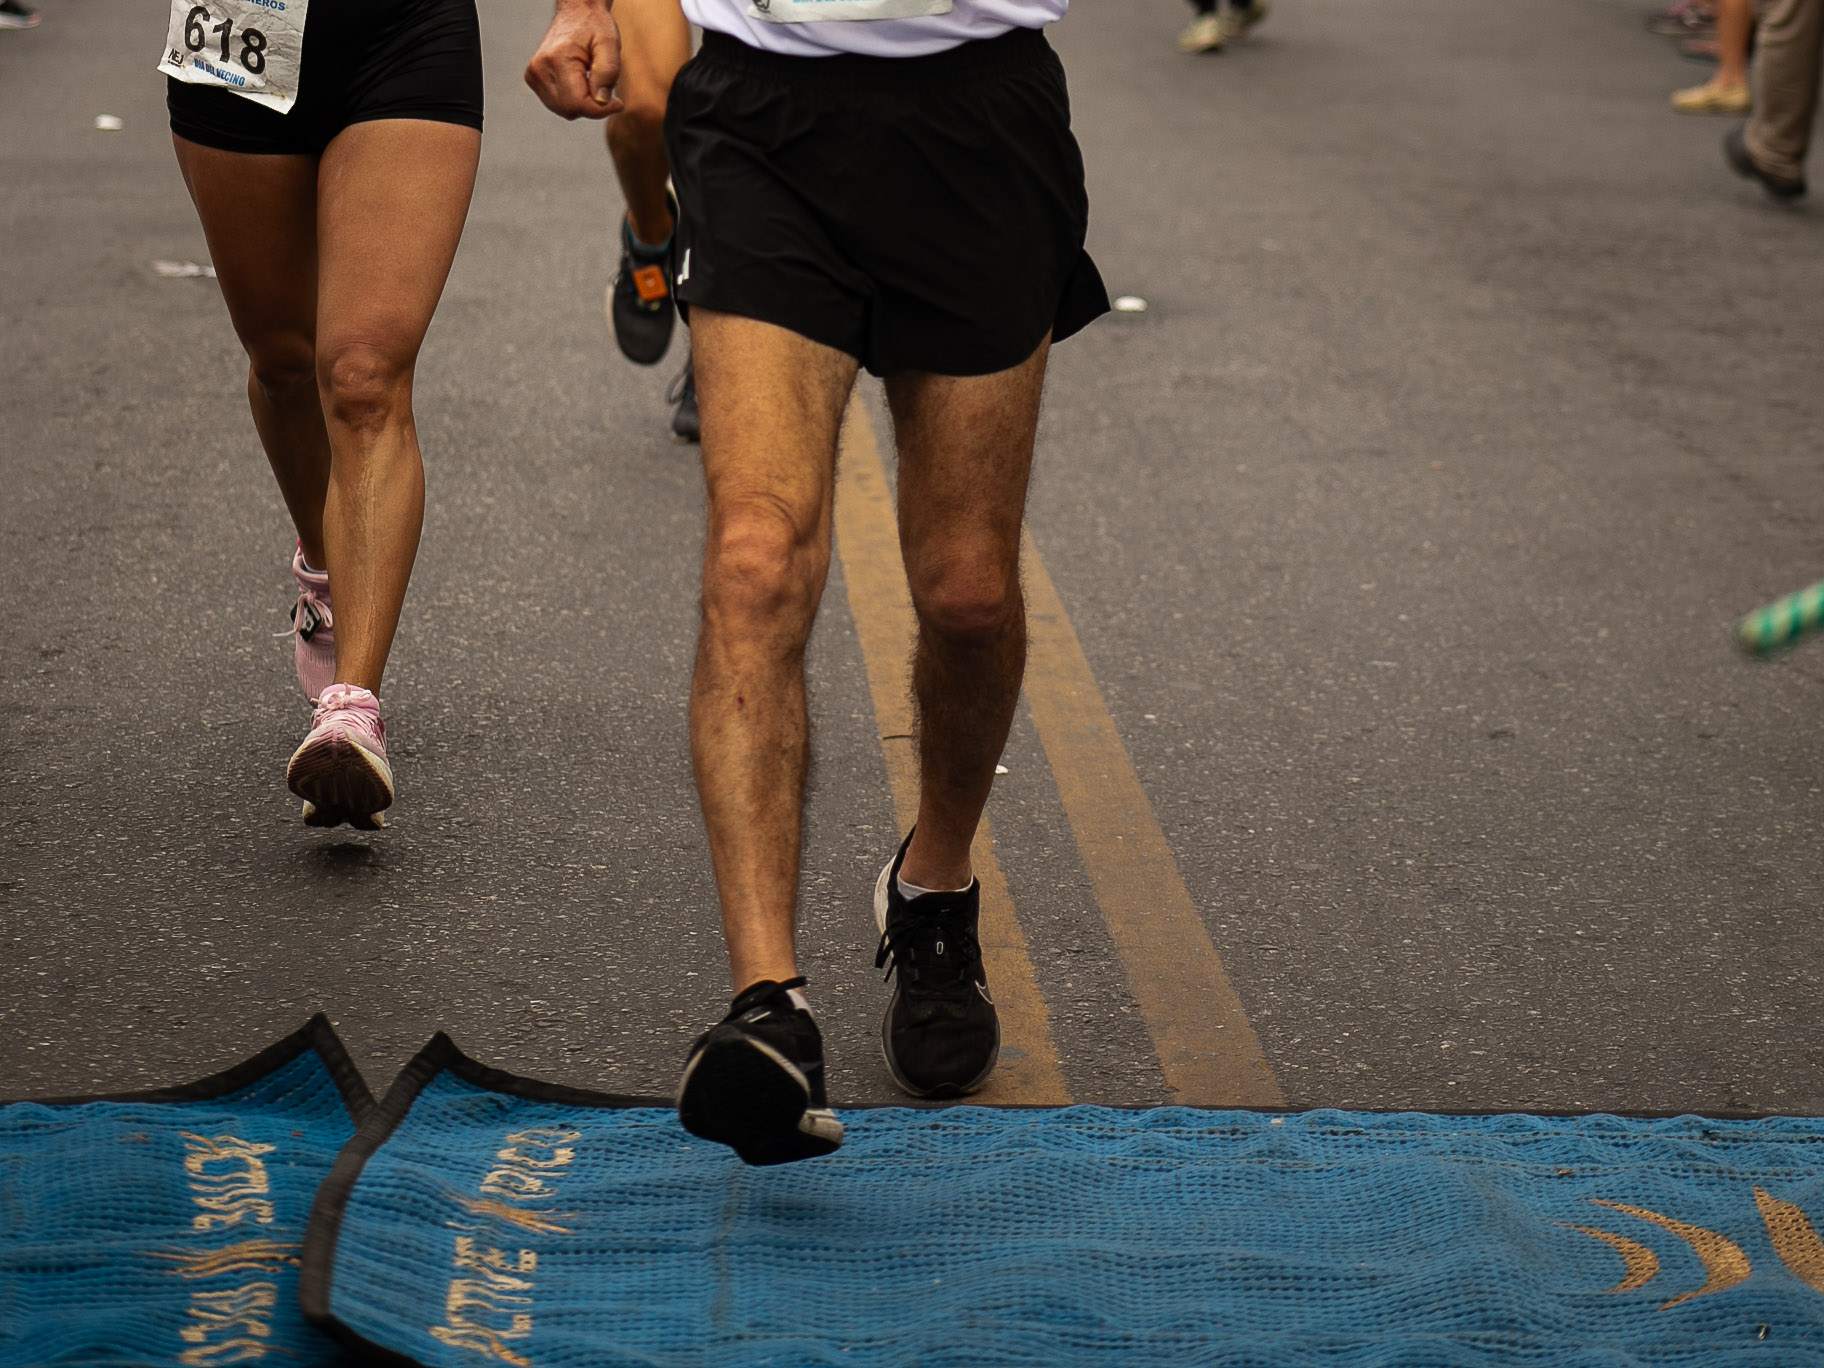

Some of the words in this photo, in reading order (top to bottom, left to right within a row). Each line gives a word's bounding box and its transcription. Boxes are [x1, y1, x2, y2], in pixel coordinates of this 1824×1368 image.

[184, 5, 268, 75] 618
[193, 57, 206, 72] DIA
[205, 63, 216, 76] DEL
[215, 68, 246, 87] VECINO
